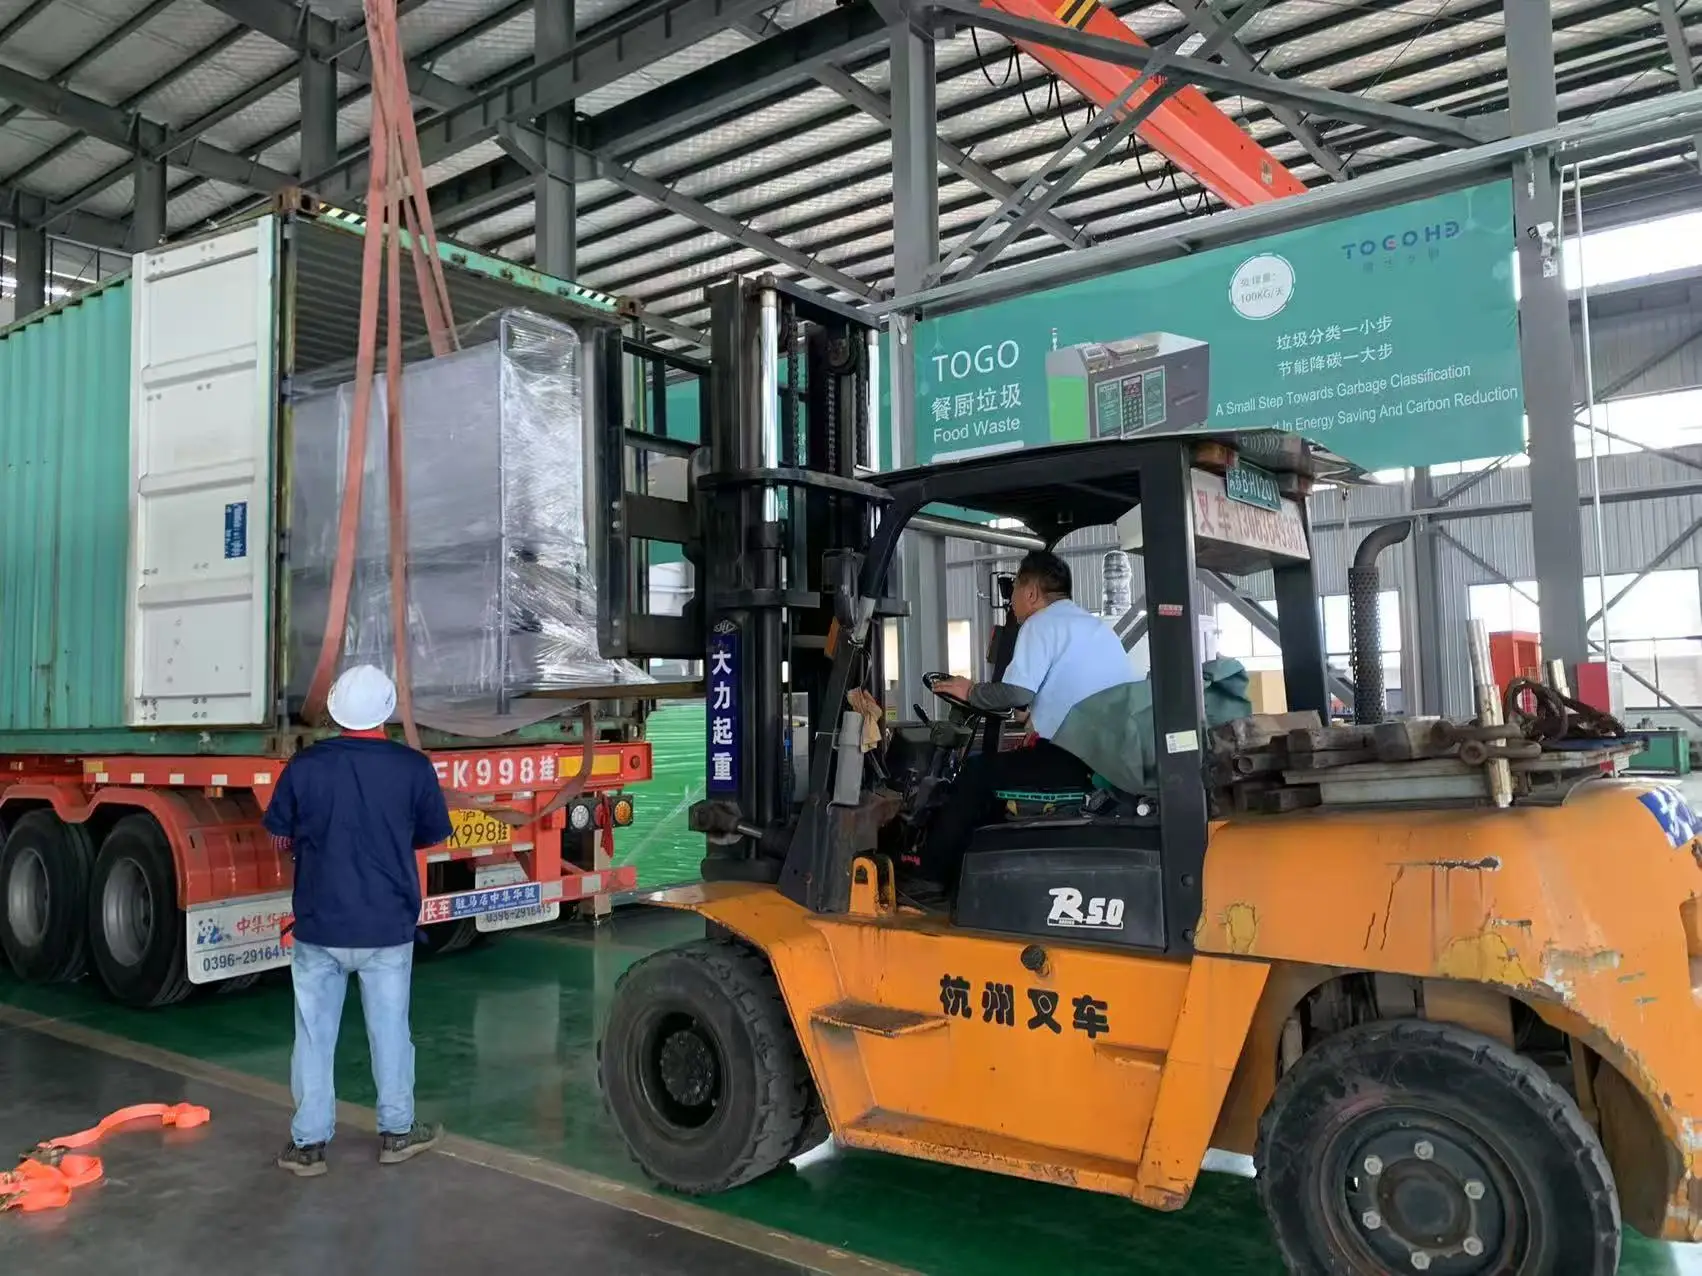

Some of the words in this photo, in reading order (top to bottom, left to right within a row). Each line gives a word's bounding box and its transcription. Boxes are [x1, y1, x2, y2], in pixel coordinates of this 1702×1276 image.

[1276, 315, 1393, 352] 垃圾分类一小步
[932, 340, 1020, 383] TOGO
[1277, 343, 1393, 378] 节能降碳一大步
[931, 383, 1022, 423] 餐厨垃圾
[1215, 403, 1225, 417] A
[1226, 398, 1257, 416] Small
[1258, 395, 1284, 411] Step
[1286, 386, 1334, 405] Towards
[1337, 378, 1387, 398] Garbage
[1390, 364, 1471, 387] Classification
[1295, 411, 1334, 432] Energy
[1337, 405, 1377, 425] Saving
[1379, 400, 1403, 418] And
[1406, 394, 1451, 415] Carbon
[1454, 386, 1519, 407] Reduction
[934, 423, 969, 444] Food
[973, 416, 1021, 438] Waste
[712, 650, 733, 781] 大力起重
[1048, 887, 1125, 926] R50
[939, 973, 1110, 1039] 杭州叉车
